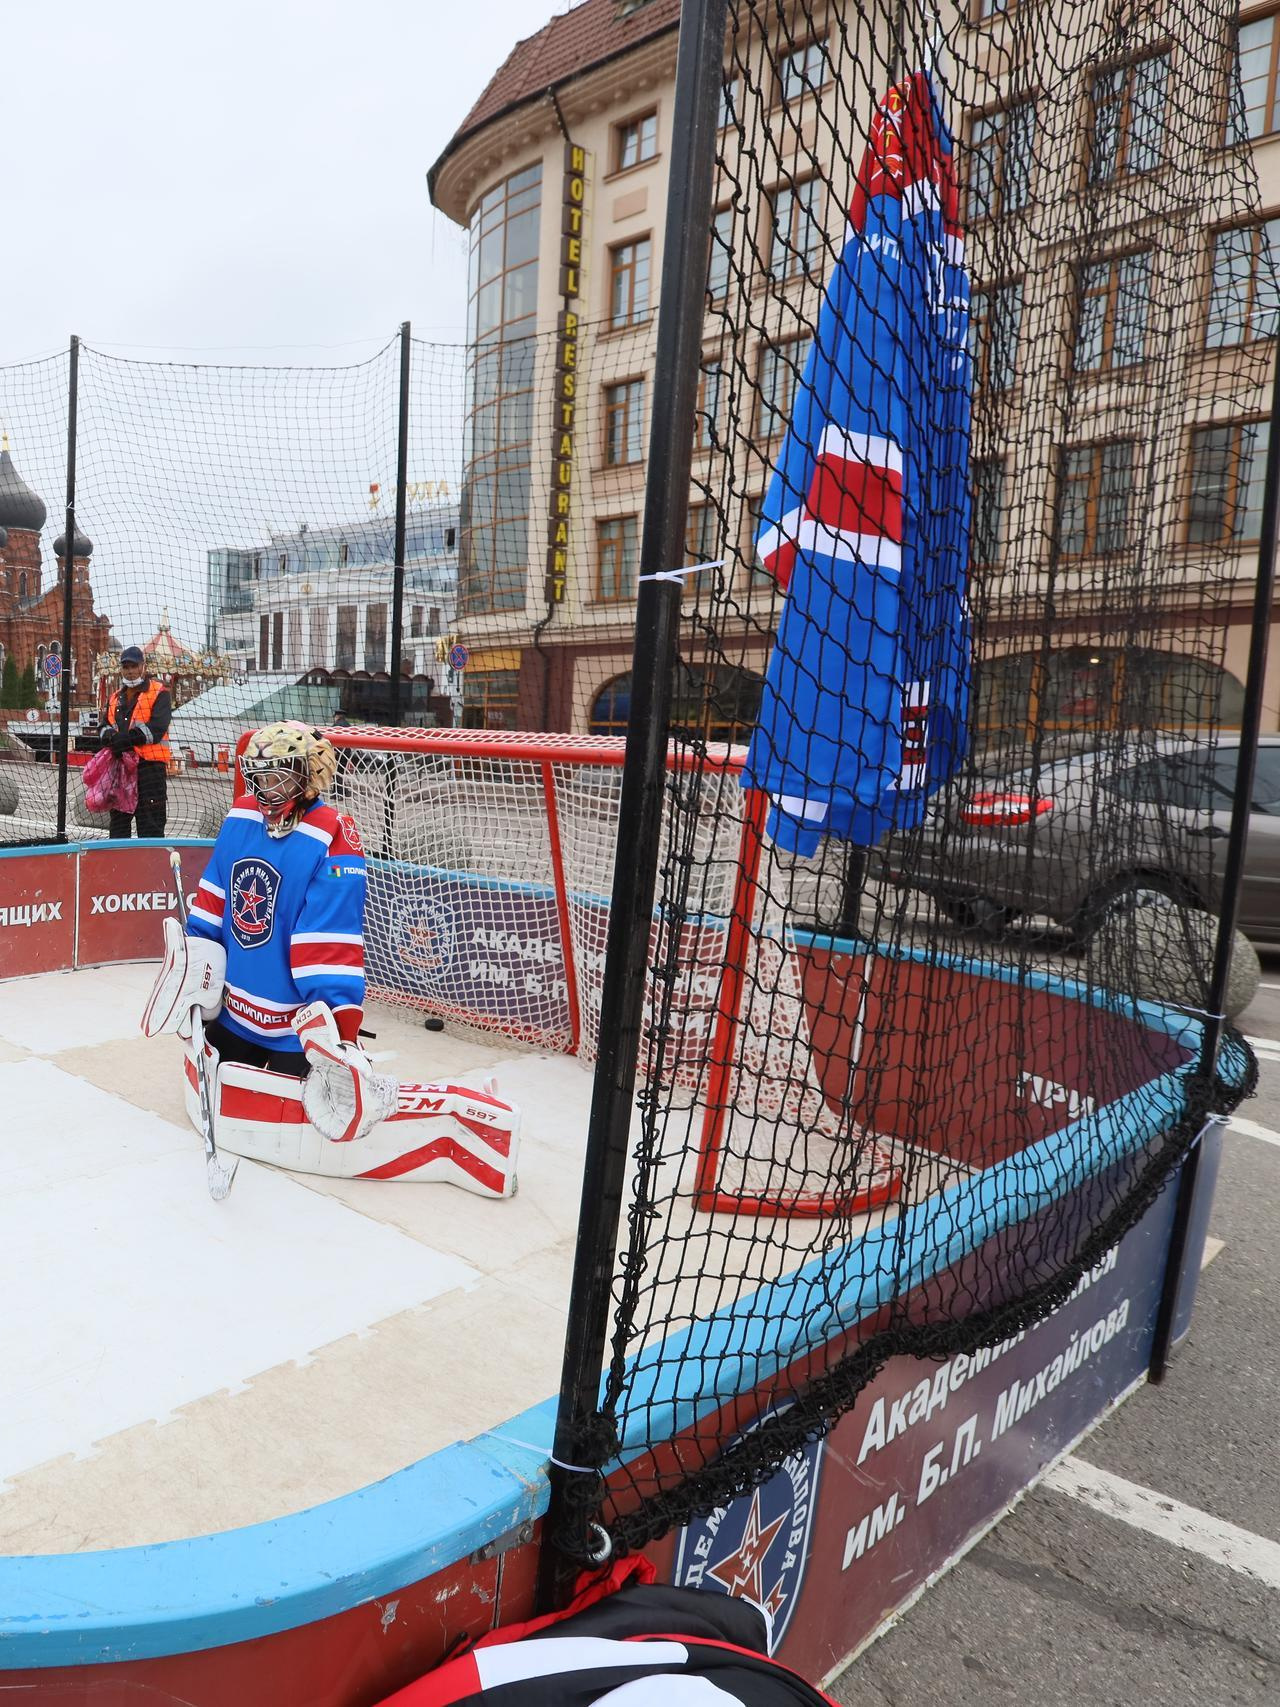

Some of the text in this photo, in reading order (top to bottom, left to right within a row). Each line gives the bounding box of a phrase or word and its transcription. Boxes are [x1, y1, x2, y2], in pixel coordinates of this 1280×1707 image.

[567, 146, 585, 293] HOTEL
[553, 313, 578, 600] RESTAURANT
[202, 963, 212, 990] 597
[228, 997, 289, 1024] ПОЛИПЛАСТ
[465, 1107, 498, 1121] 597
[841, 1492, 905, 1571] им.
[916, 1413, 982, 1506] Б.П.
[991, 1299, 1130, 1442] Михайлова
